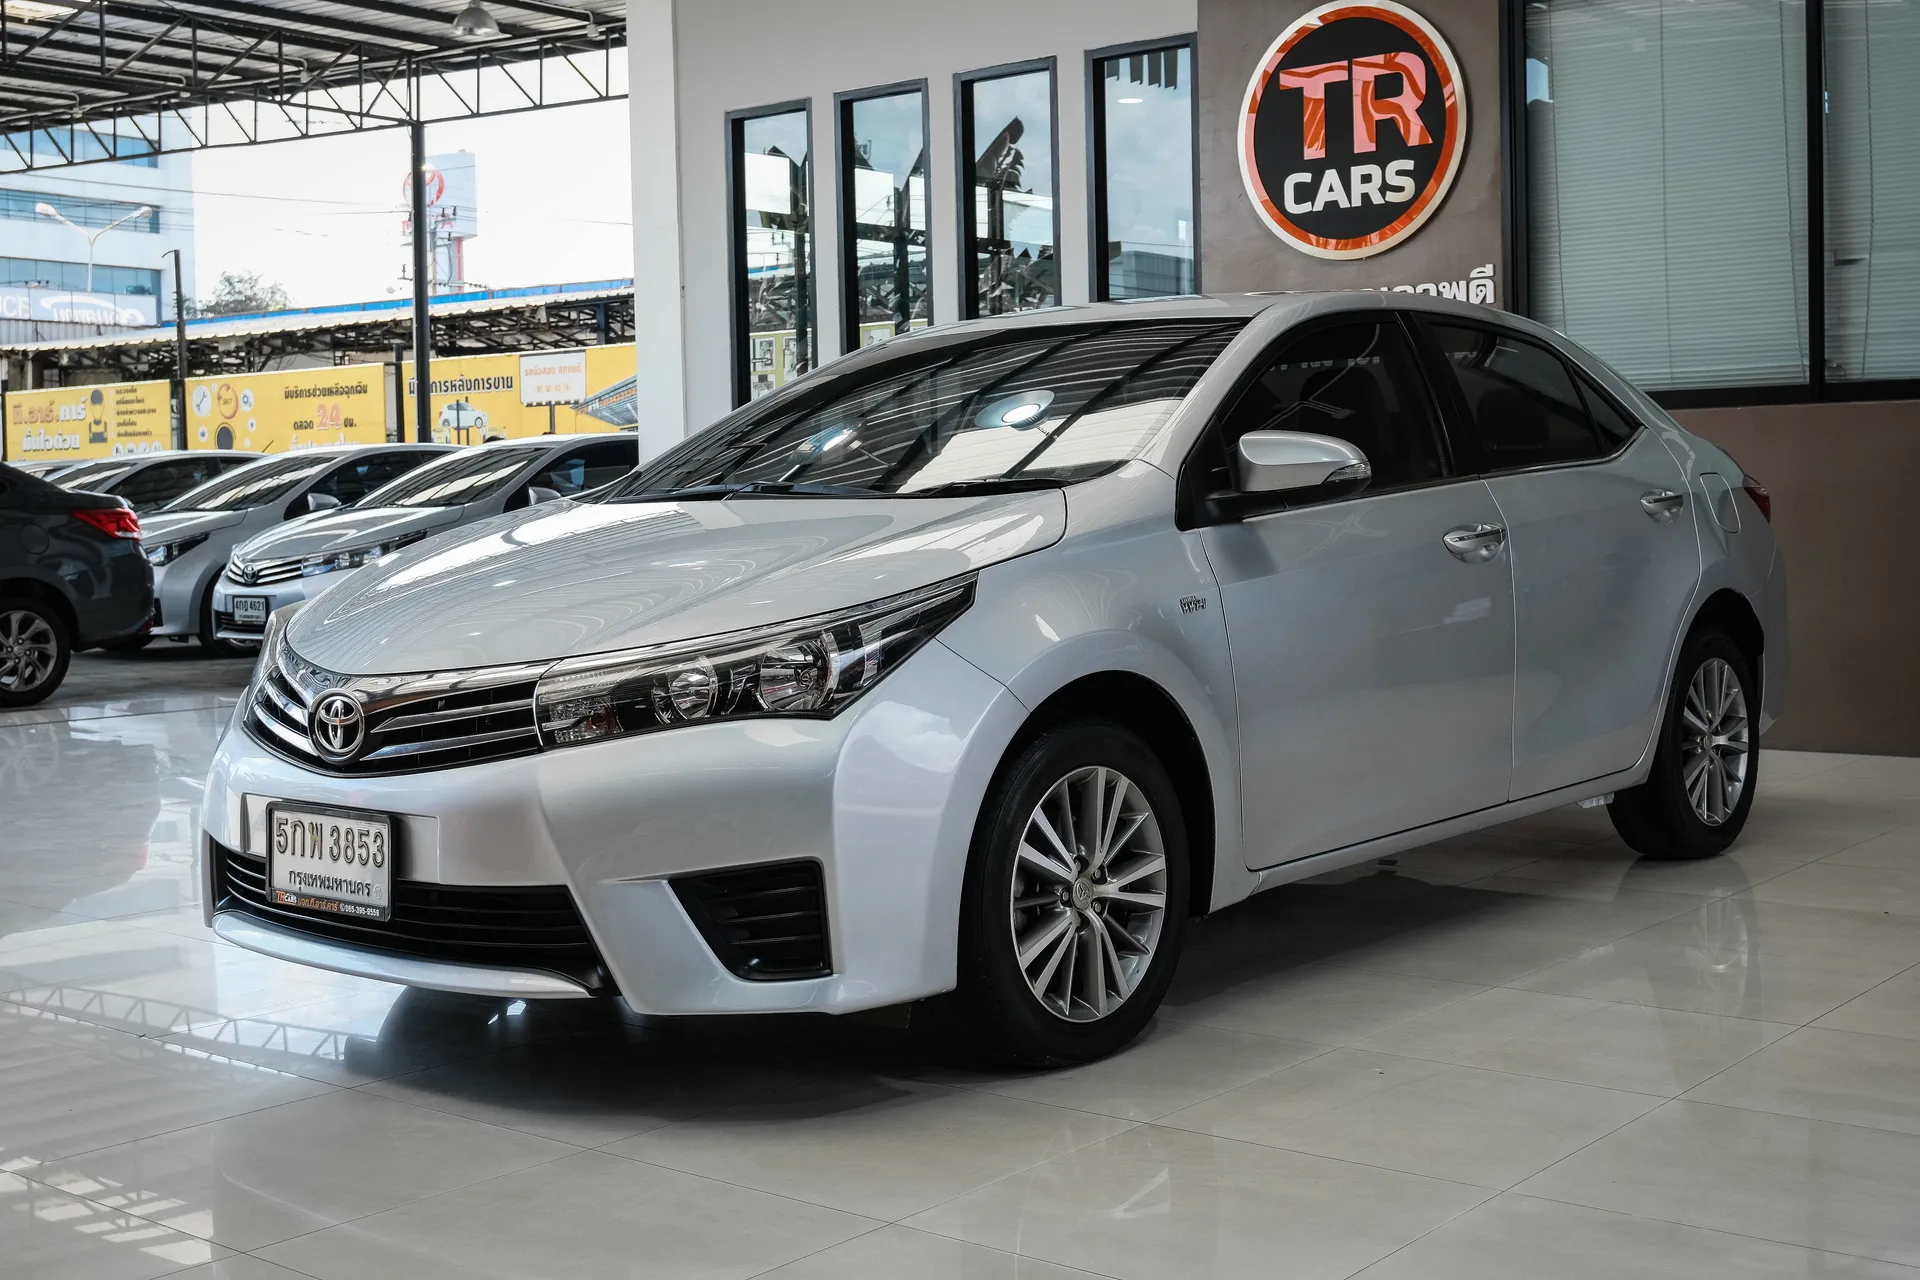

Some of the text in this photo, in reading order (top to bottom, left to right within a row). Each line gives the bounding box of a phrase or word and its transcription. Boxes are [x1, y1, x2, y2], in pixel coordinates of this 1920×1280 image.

[1279, 52, 1434, 161] TR
[1283, 159, 1416, 215] CARS
[0, 295, 33, 318] CE
[293, 419, 314, 431] ตลอด
[316, 403, 342, 430] 24
[249, 600, 265, 611] 4621
[329, 824, 385, 868] 3853
[288, 869, 371, 897] กรุงเทพมหานคร
